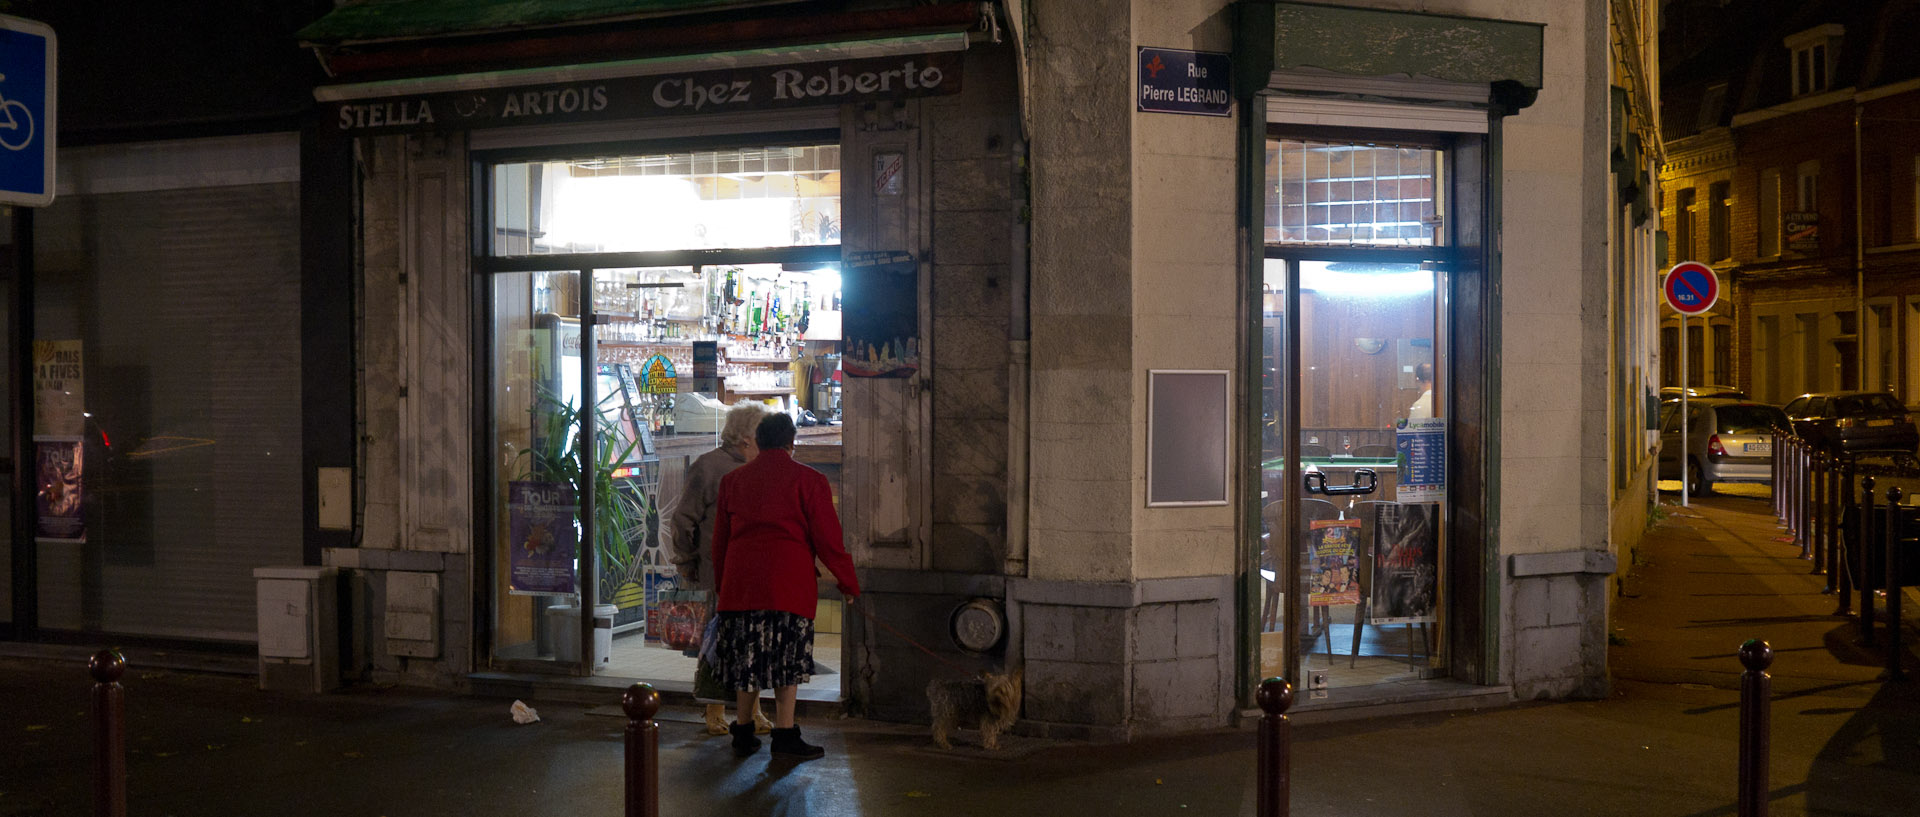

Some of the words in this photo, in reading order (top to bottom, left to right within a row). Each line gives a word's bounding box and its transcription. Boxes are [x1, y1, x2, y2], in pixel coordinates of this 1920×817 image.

[1187, 62, 1208, 79] Rue
[652, 77, 752, 112] Chez
[771, 60, 944, 100] Roberto
[1142, 84, 1175, 101] Pierre
[1177, 86, 1228, 105] LEGRAND
[338, 100, 435, 130] STELLA
[502, 85, 608, 119] ARTOIS
[49, 364, 80, 379] FIVES
[1409, 421, 1444, 430] Lycamobile
[520, 488, 560, 506] TOUR
